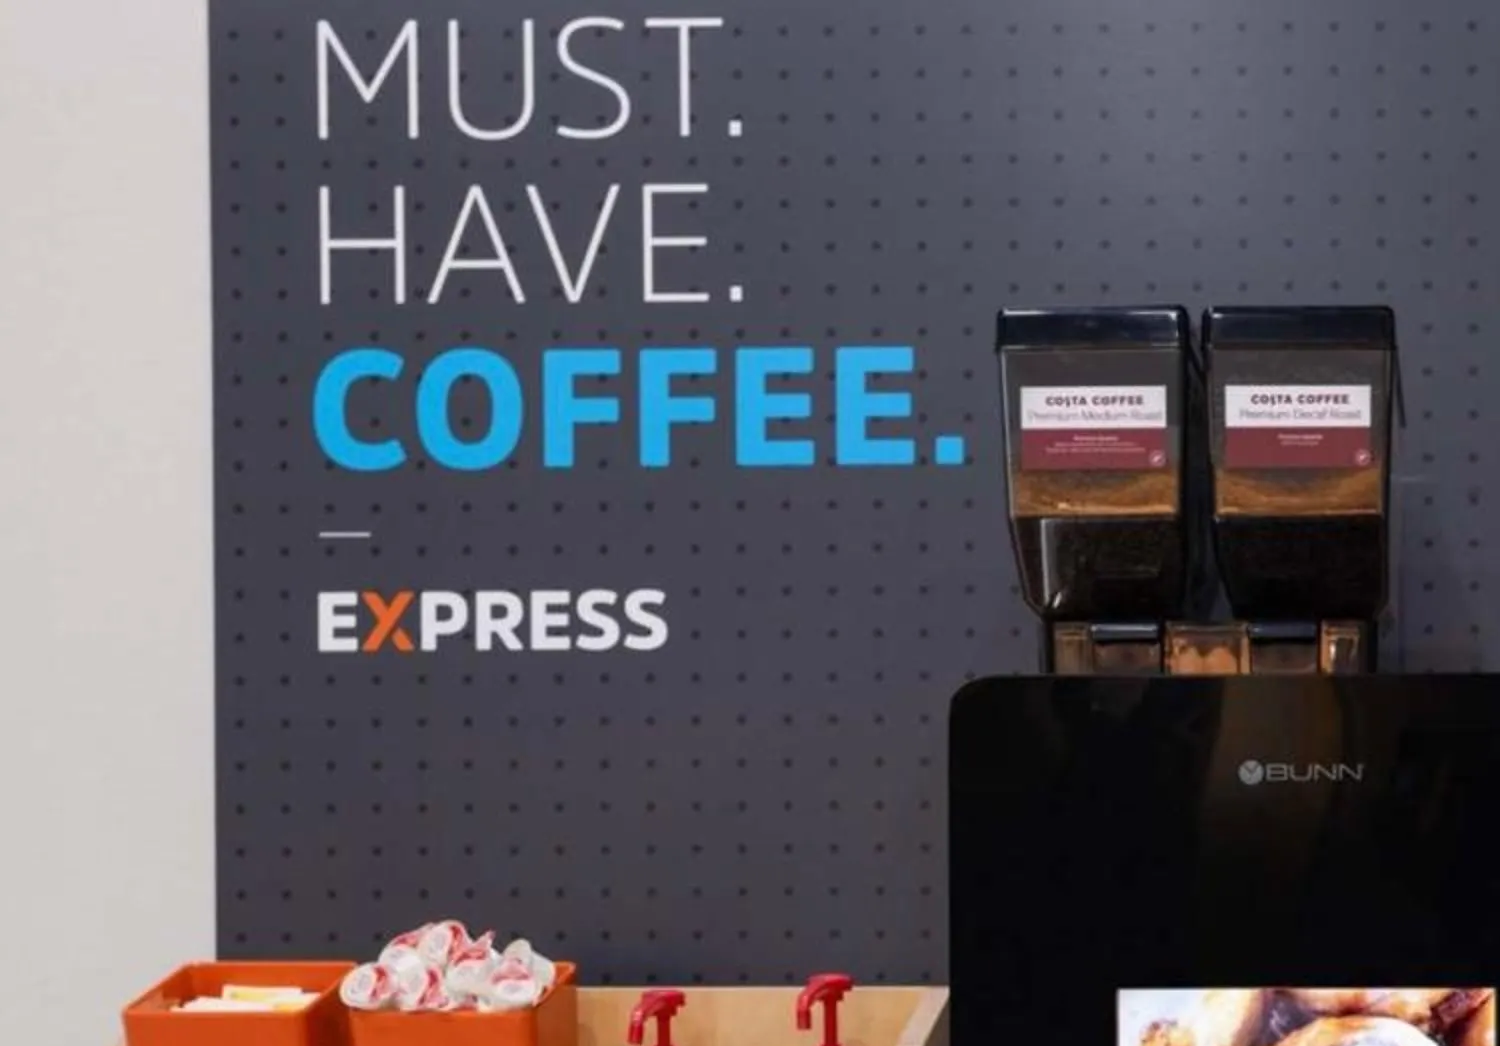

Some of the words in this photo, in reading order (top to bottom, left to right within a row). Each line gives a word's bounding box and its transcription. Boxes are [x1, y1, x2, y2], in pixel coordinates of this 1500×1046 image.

[317, 16, 742, 140] MUST.
[319, 183, 743, 305] HAVE.
[312, 346, 965, 471] COFFEE.
[1045, 394, 1087, 408] COSTA
[1092, 394, 1145, 406] COFFEE
[1250, 393, 1292, 407] COSTA
[1297, 393, 1350, 405] COFFEE
[317, 588, 668, 652] EXPRESS
[1265, 763, 1364, 782] BUNN
